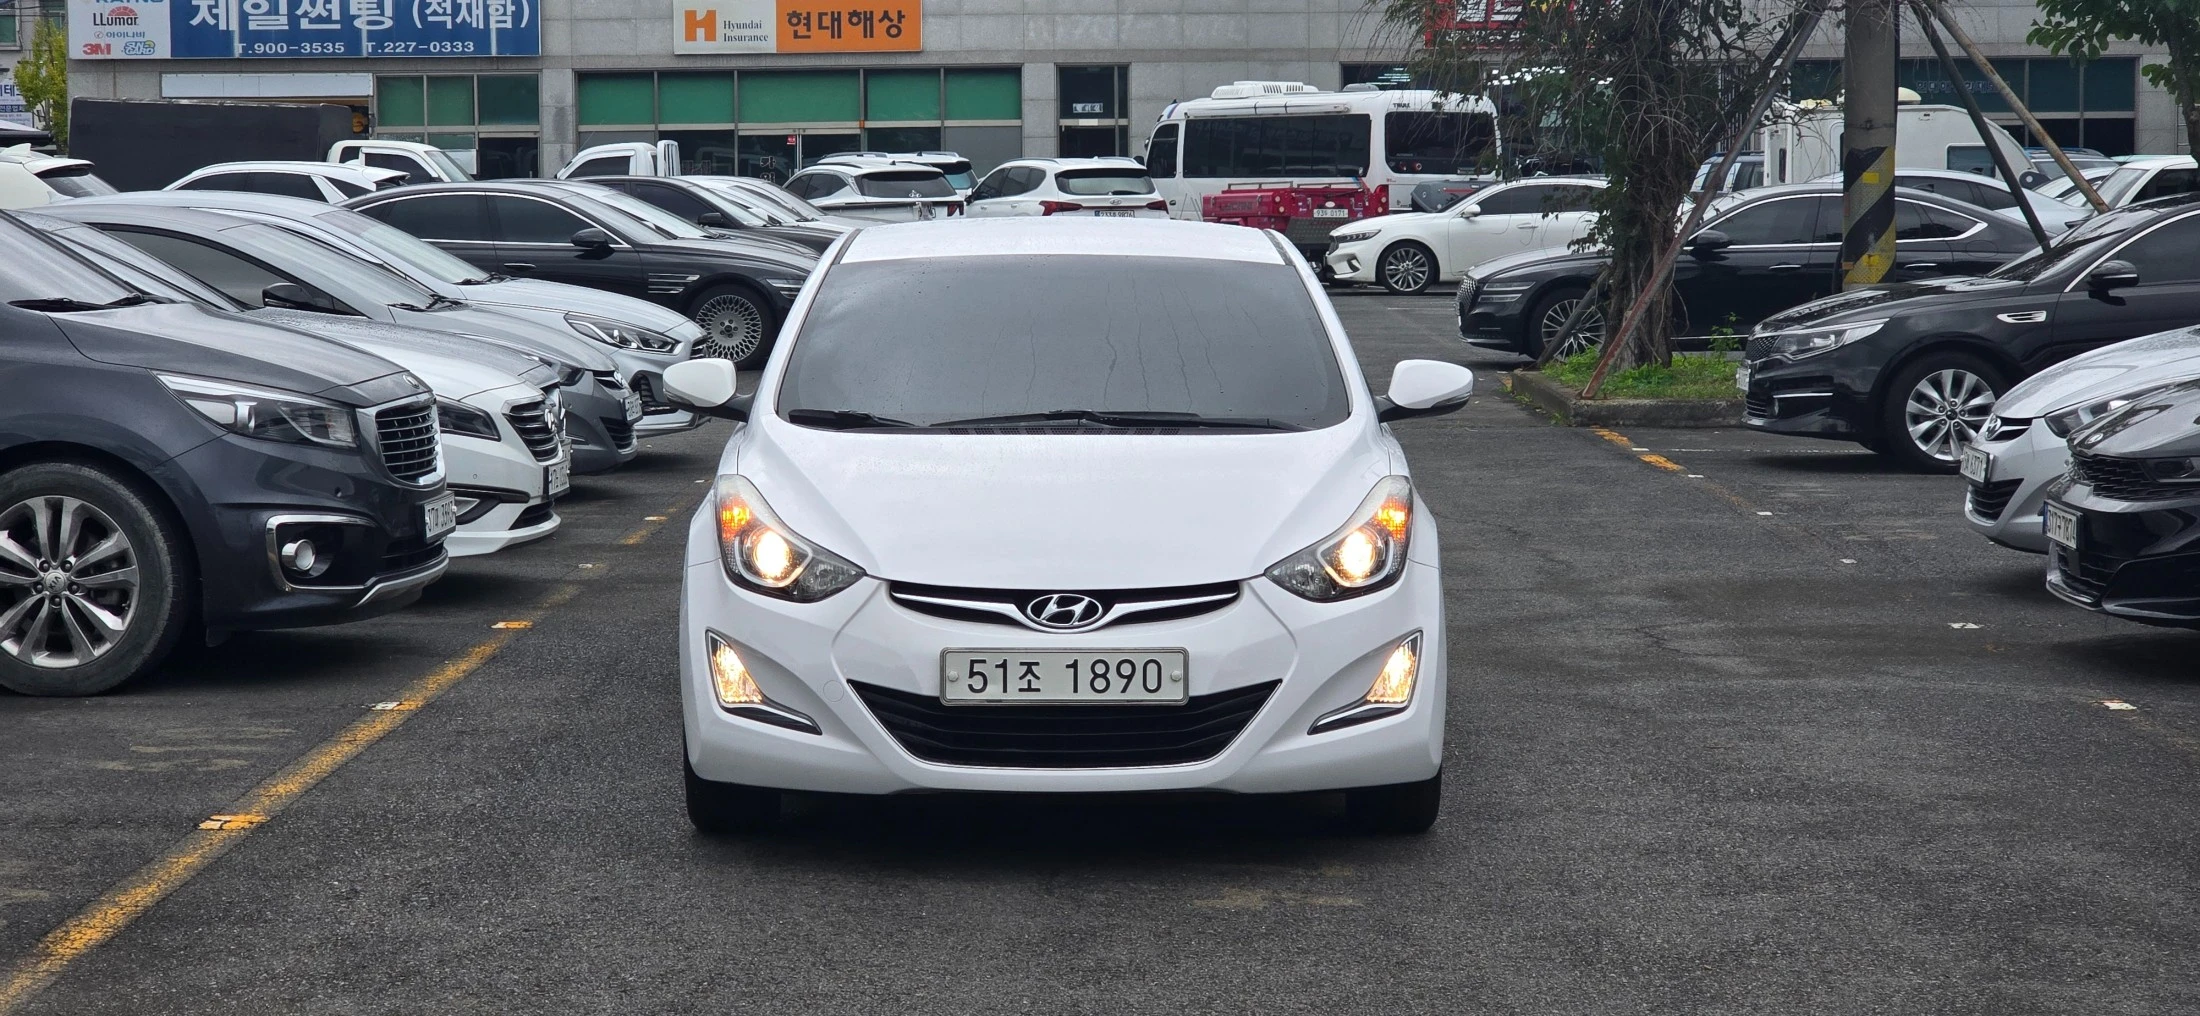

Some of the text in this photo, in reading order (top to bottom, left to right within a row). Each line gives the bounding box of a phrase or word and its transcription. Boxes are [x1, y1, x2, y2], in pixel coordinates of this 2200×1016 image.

[93, 12, 139, 26] LLumar
[190, 0, 530, 30] 제일썬팅 (적재함)
[723, 20, 763, 32] Hyundai
[786, 9, 906, 39] 현대해상
[106, 31, 146, 39] 아이나비
[723, 33, 769, 43] Insurance
[82, 43, 112, 55] 3M
[125, 47, 155, 55] CARD
[236, 41, 475, 54] T.900-3535 T.227-0333
[968, 659, 1163, 694] 51조 1890
